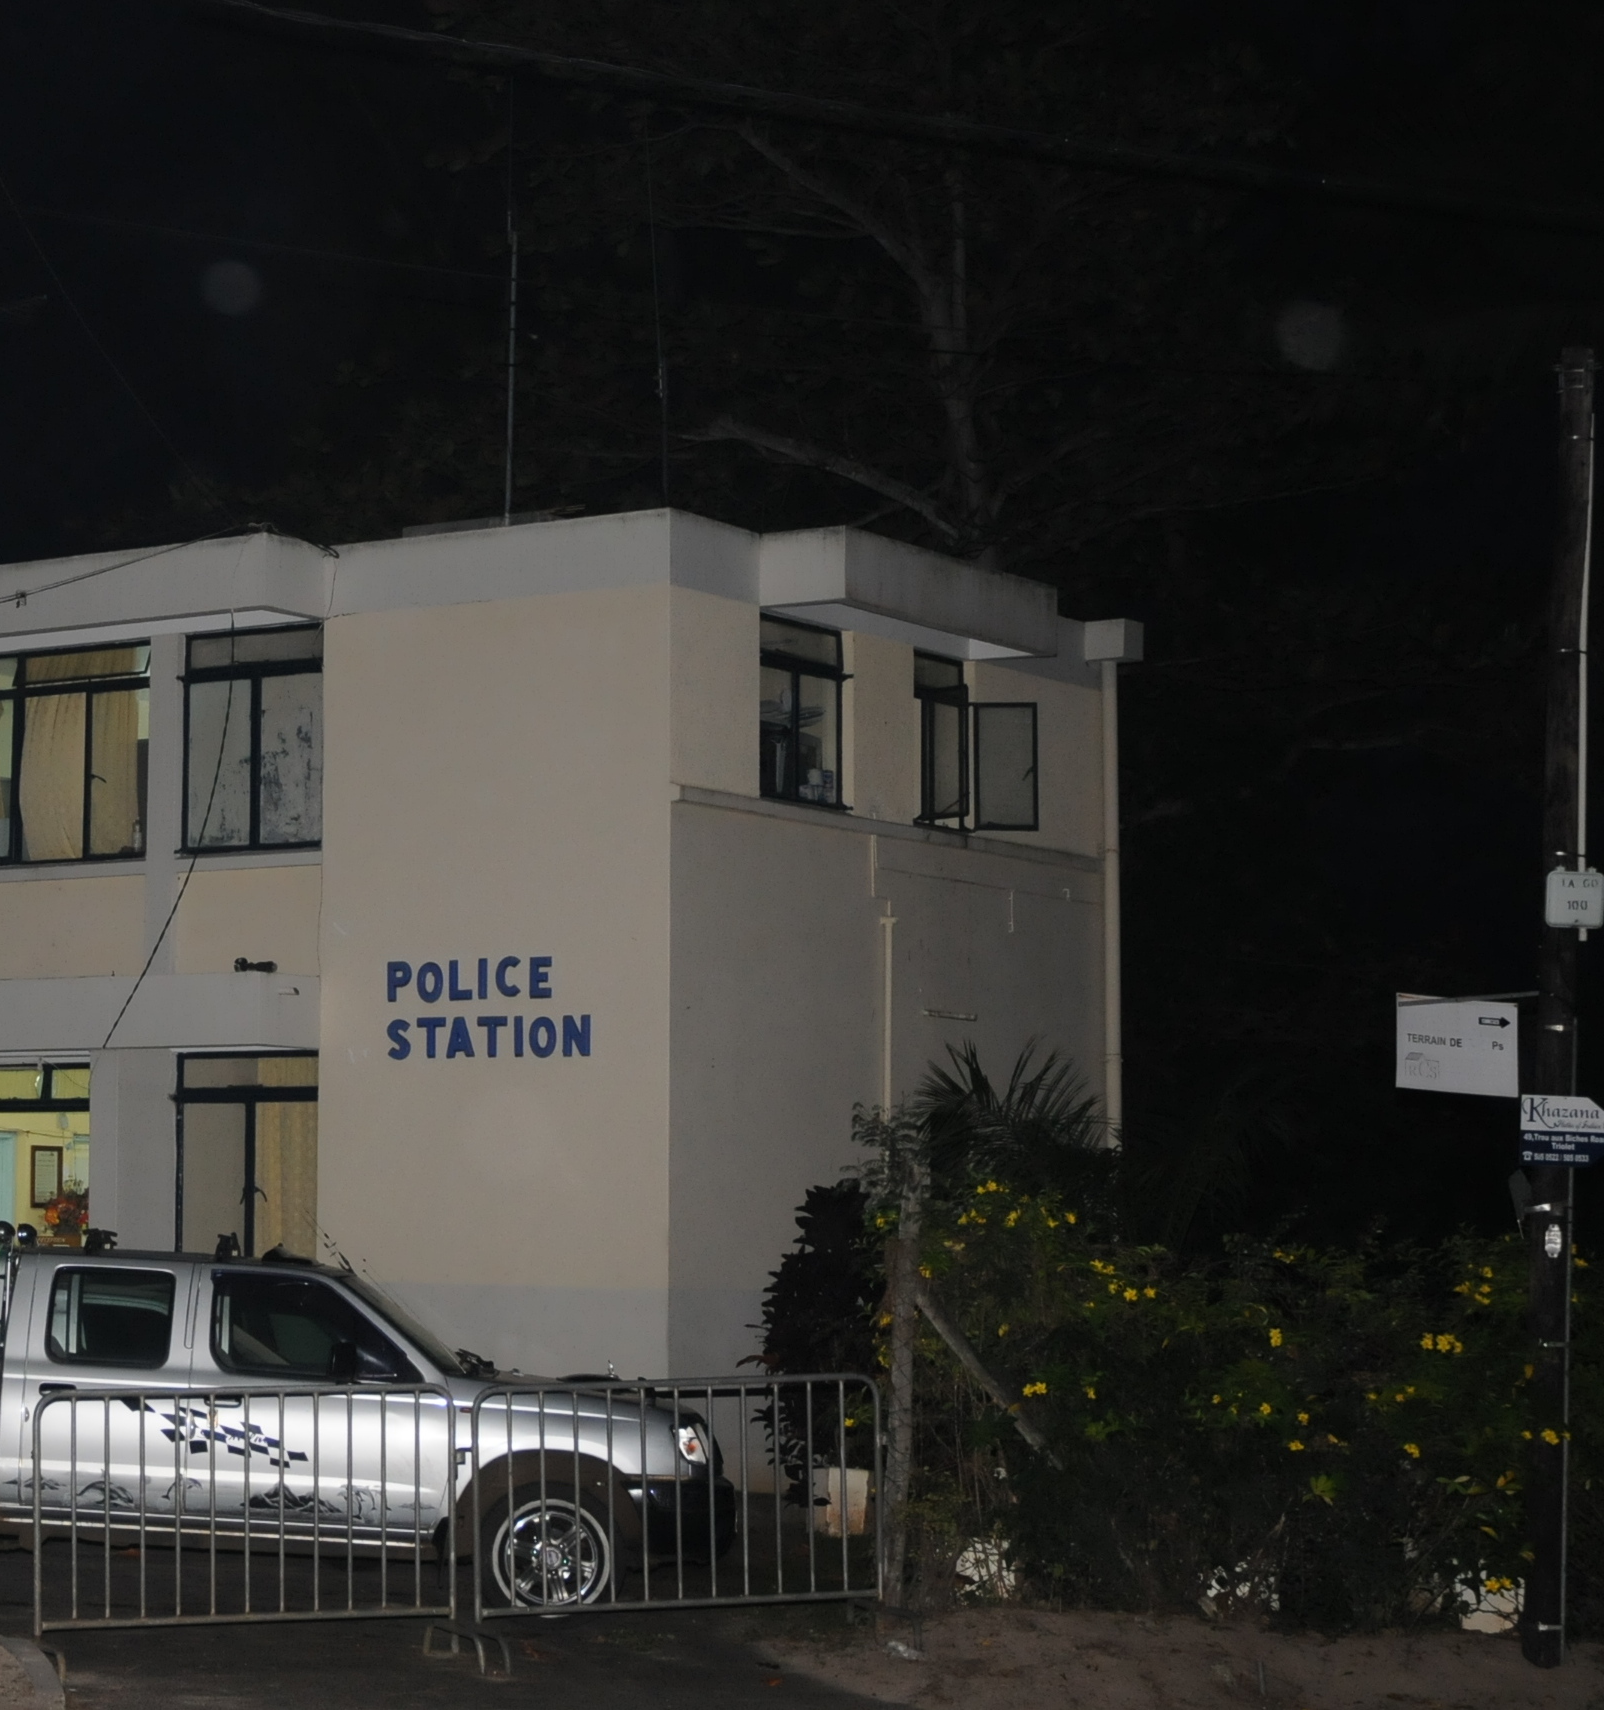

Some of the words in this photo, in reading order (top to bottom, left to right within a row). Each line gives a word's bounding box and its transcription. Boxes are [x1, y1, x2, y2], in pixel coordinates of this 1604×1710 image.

[387, 956, 552, 1003] POLICE
[386, 1014, 591, 1060] STATION
[1407, 1033, 1446, 1046] TERRAIN
[1449, 1038, 1463, 1048] DE
[1492, 1041, 1504, 1051] Ps
[1522, 1097, 1600, 1129] Khazana
[1551, 1142, 1575, 1150] Triolet
[1565, 1134, 1588, 1142] Biches
